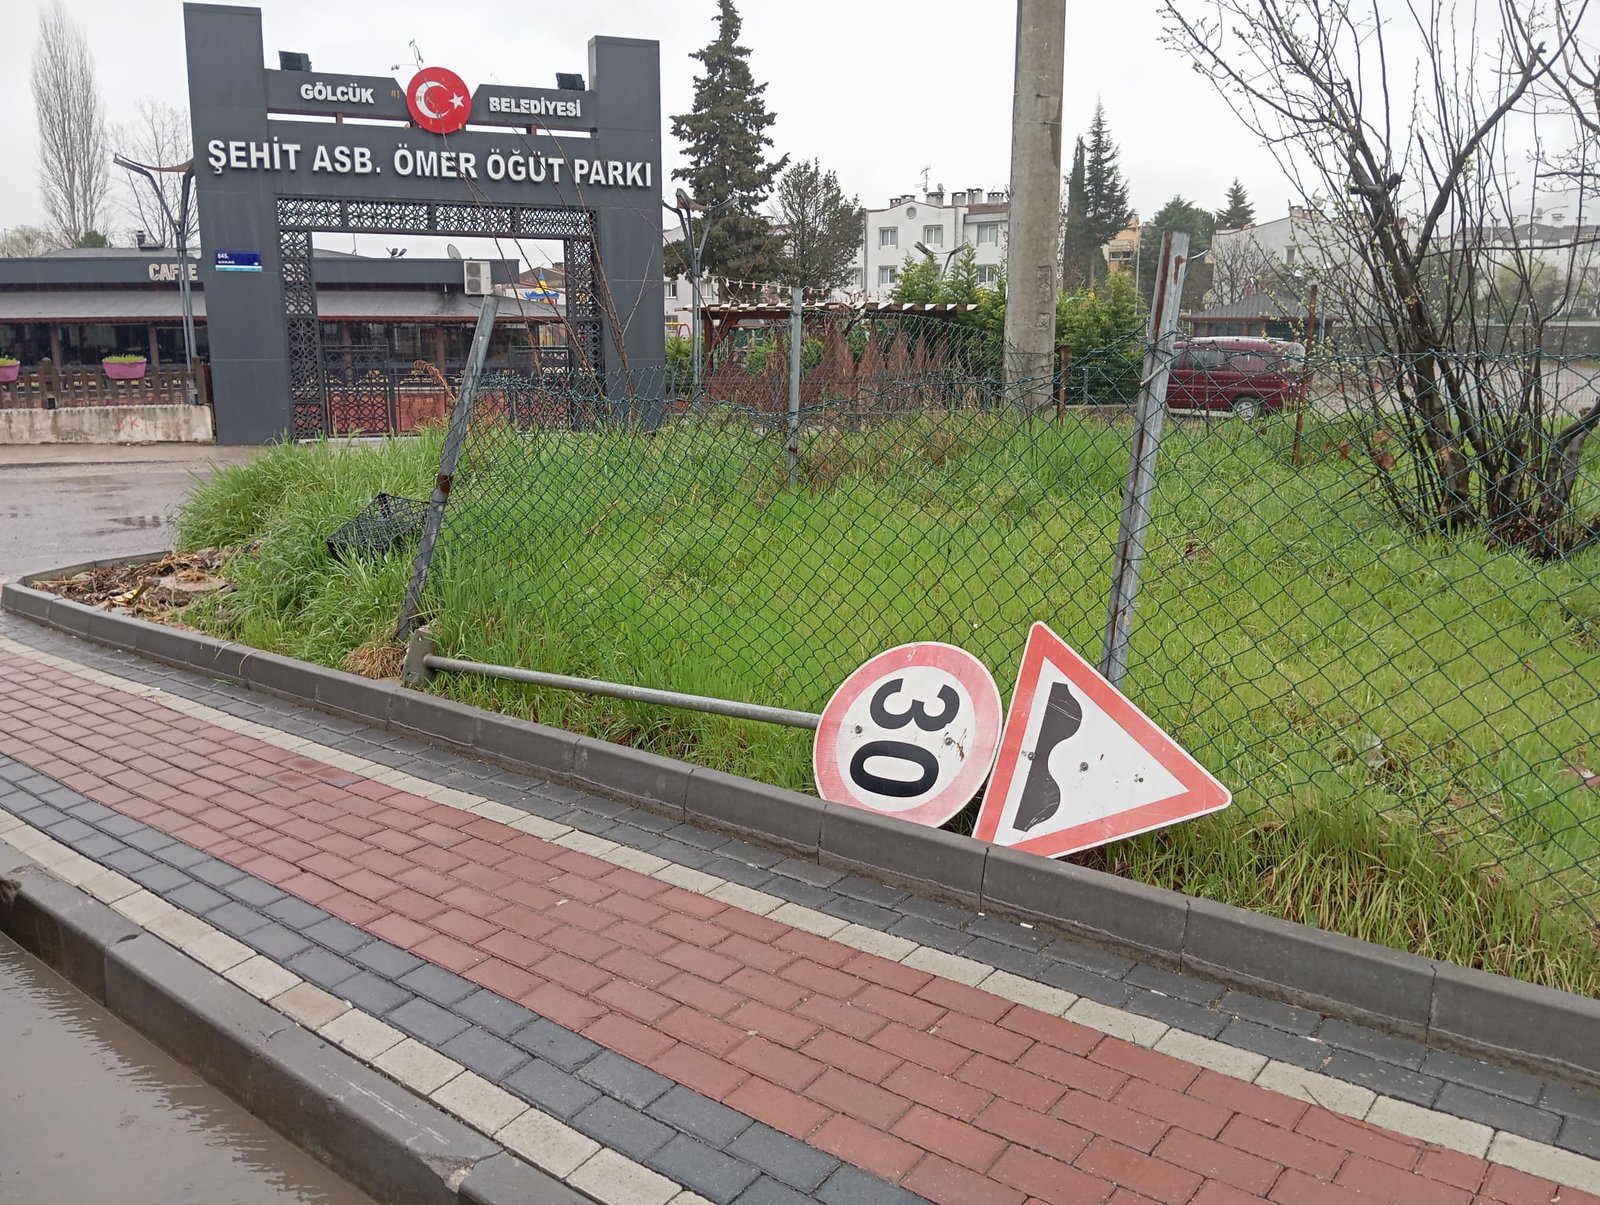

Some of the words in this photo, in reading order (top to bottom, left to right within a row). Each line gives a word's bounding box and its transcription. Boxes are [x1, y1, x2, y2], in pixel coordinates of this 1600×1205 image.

[300, 82, 375, 104] GÖLCÜK
[488, 96, 582, 118] BELEDİYESİ
[208, 136, 301, 174] ŞEHİT
[312, 145, 382, 174] ASB.
[393, 143, 478, 180] ÖMER
[486, 148, 565, 183] ÖĞÜT
[573, 158, 652, 187] PARKI
[849, 677, 961, 798] 30
